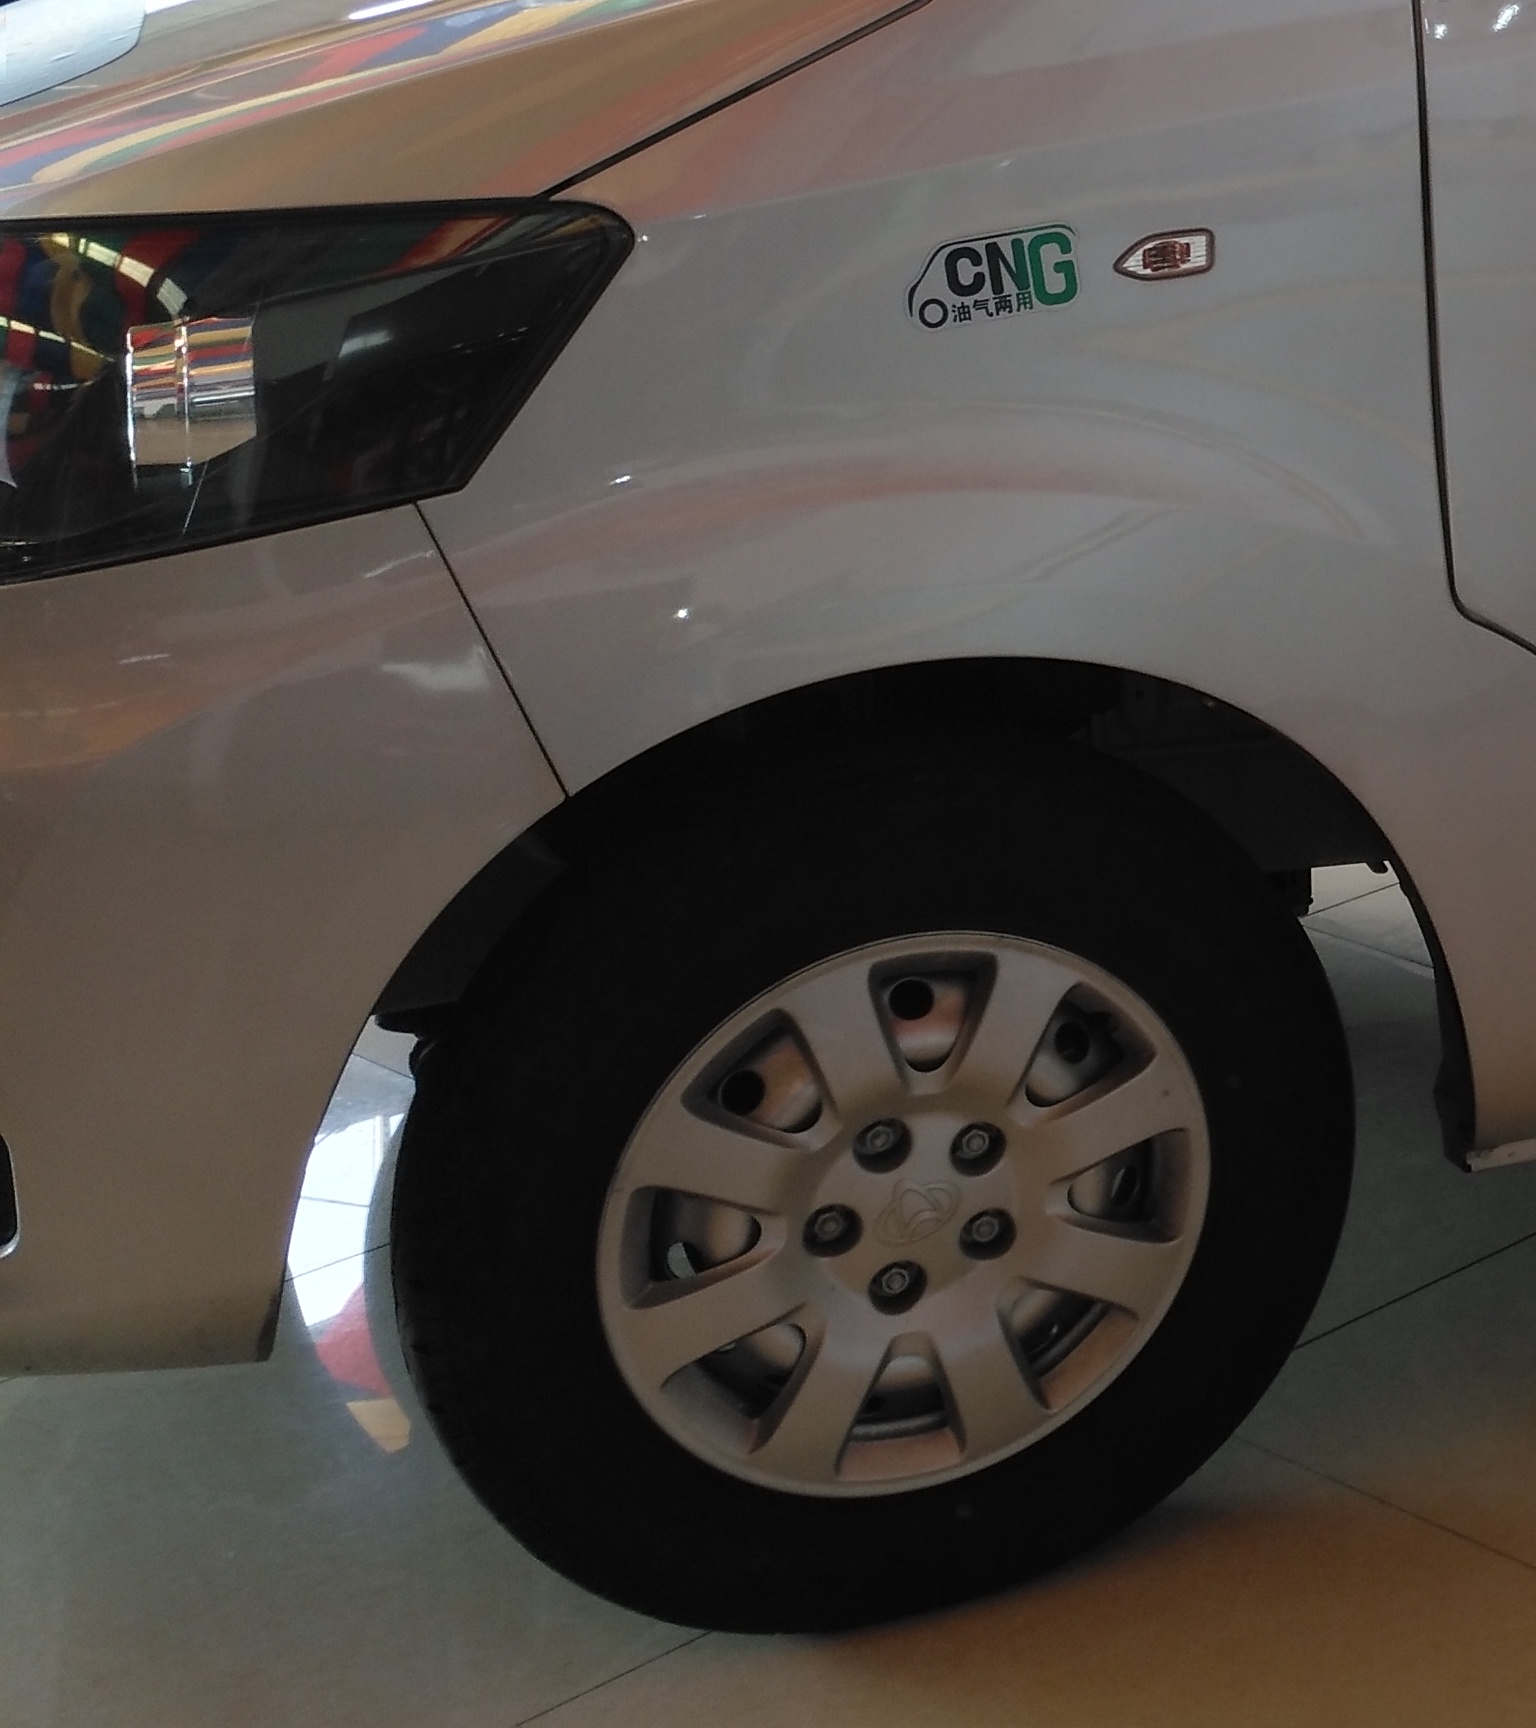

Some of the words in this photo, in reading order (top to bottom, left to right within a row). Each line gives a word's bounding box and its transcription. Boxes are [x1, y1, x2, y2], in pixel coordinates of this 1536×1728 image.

[944, 231, 1078, 307] CNG
[952, 290, 1035, 323] 油气两用
